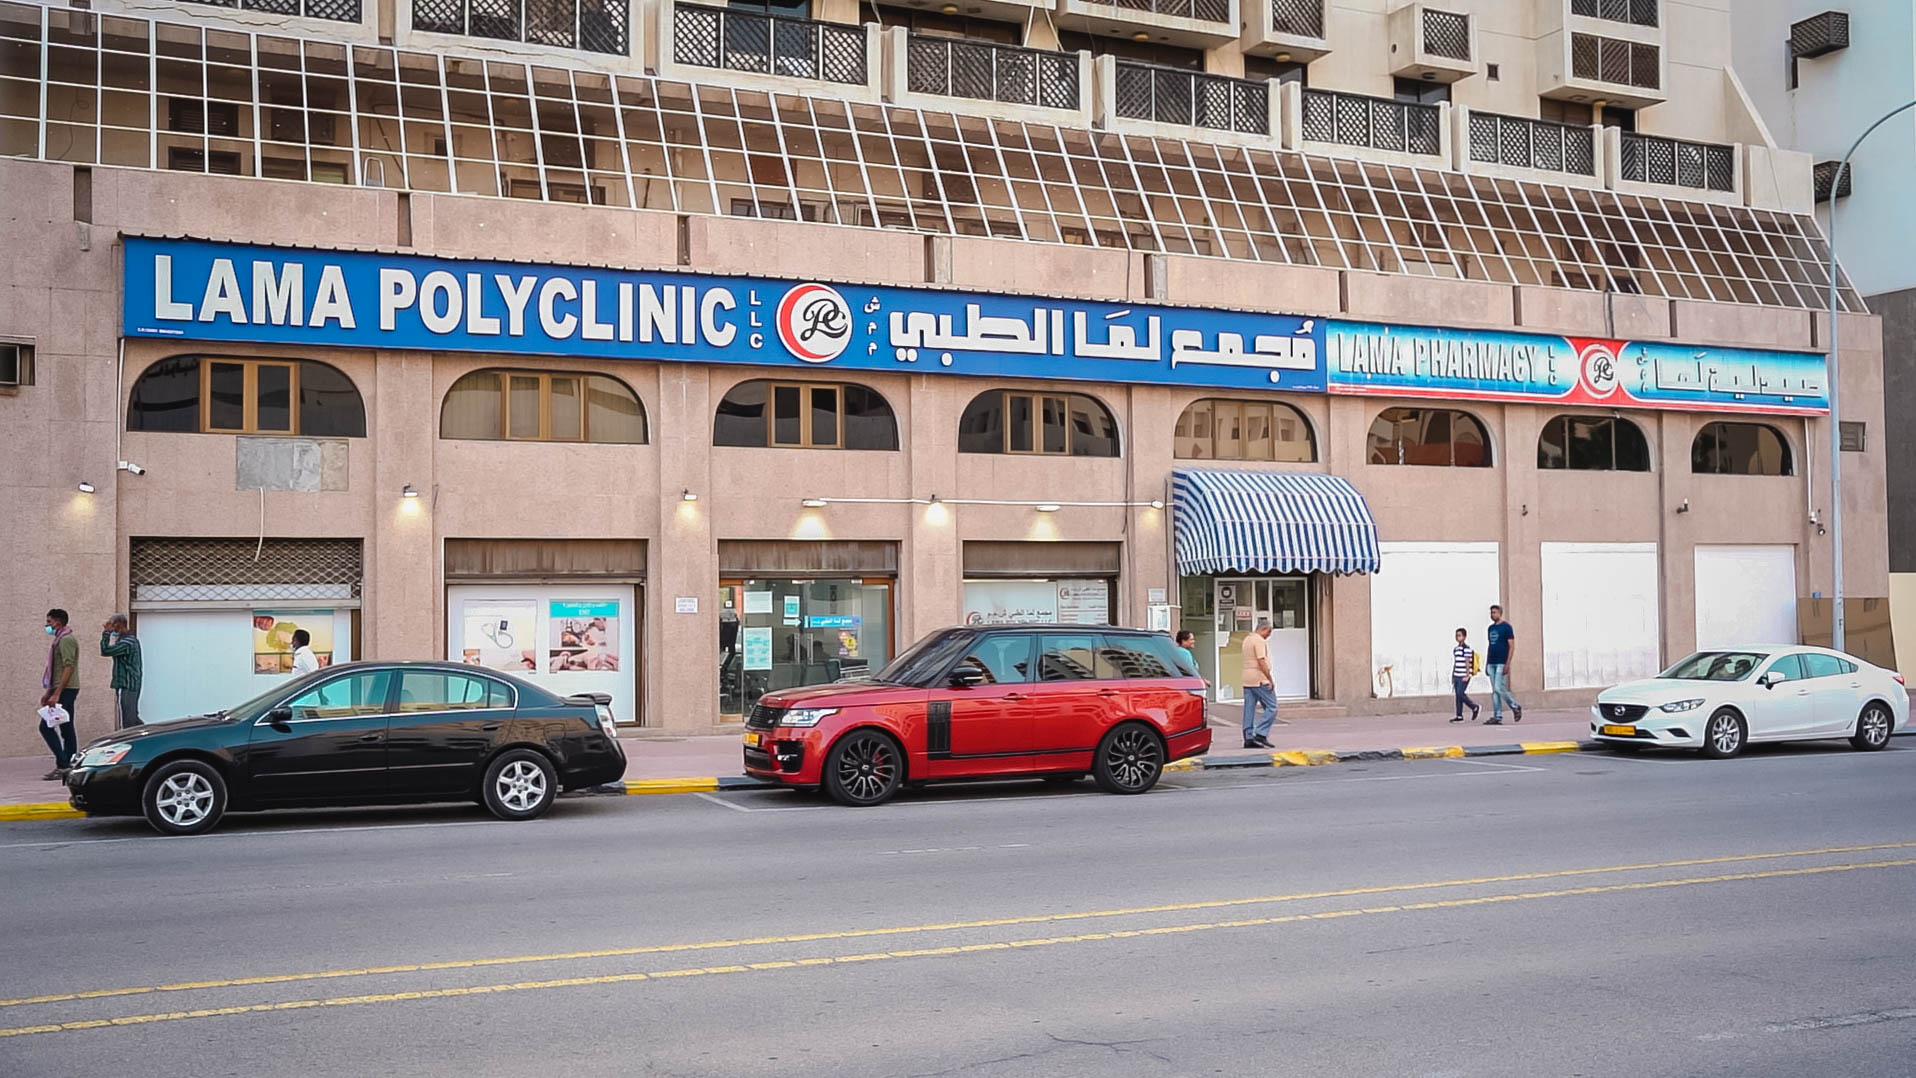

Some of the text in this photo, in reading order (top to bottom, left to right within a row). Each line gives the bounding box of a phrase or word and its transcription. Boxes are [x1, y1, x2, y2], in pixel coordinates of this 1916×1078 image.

[155, 254, 737, 346] LAMA POLYCLINIC
[888, 303, 1065, 366] الطبي
[1338, 333, 1538, 383] LAMA PHARMACY
